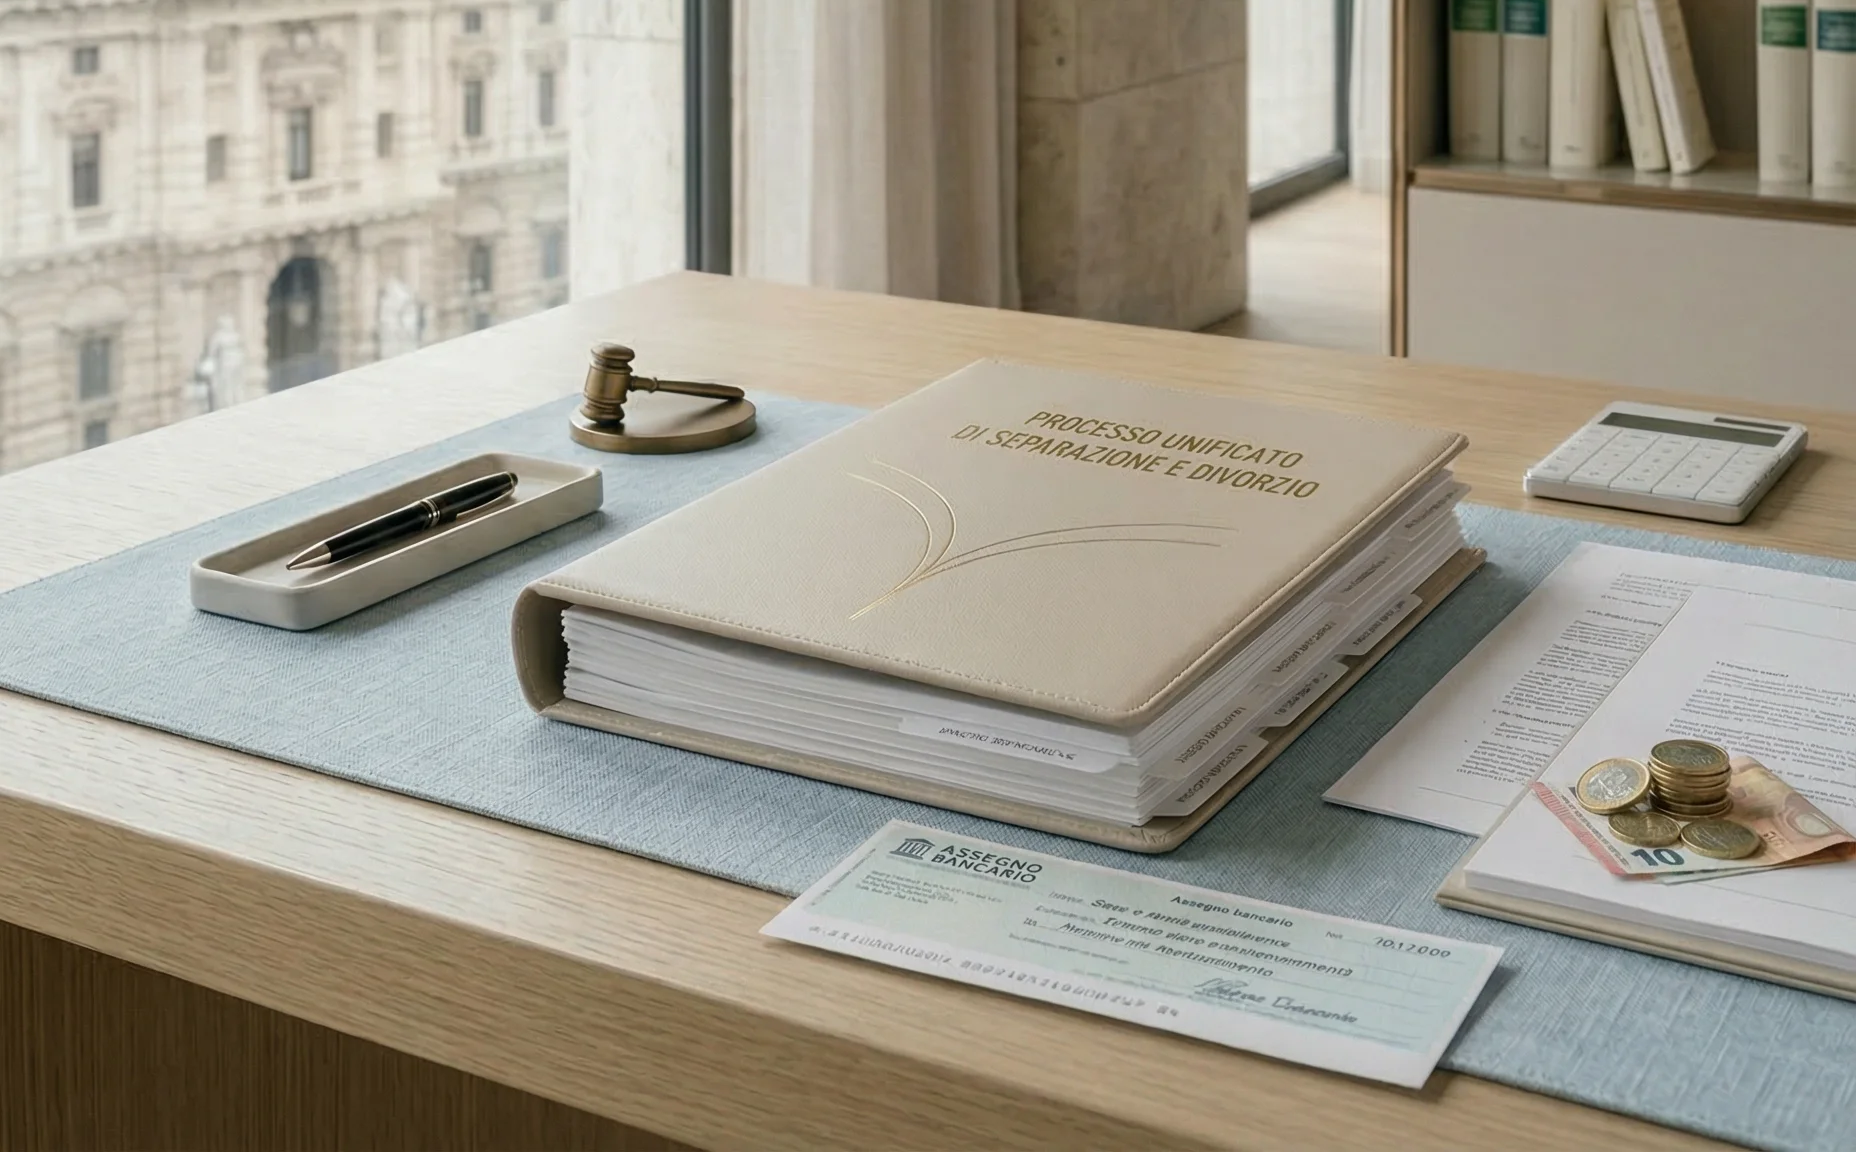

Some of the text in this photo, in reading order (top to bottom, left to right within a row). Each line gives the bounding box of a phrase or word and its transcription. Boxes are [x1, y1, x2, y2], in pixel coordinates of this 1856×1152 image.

[1024, 411, 1304, 468] PROCESSO UNIFICATO
[951, 425, 1320, 498] DI SEPARAZIONE E DIVORZIO
[931, 854, 1037, 882] BANCARIO
[940, 845, 1043, 873] ASSEGNO
[1630, 849, 1685, 866] 10
[1233, 908, 1294, 928] bancario
